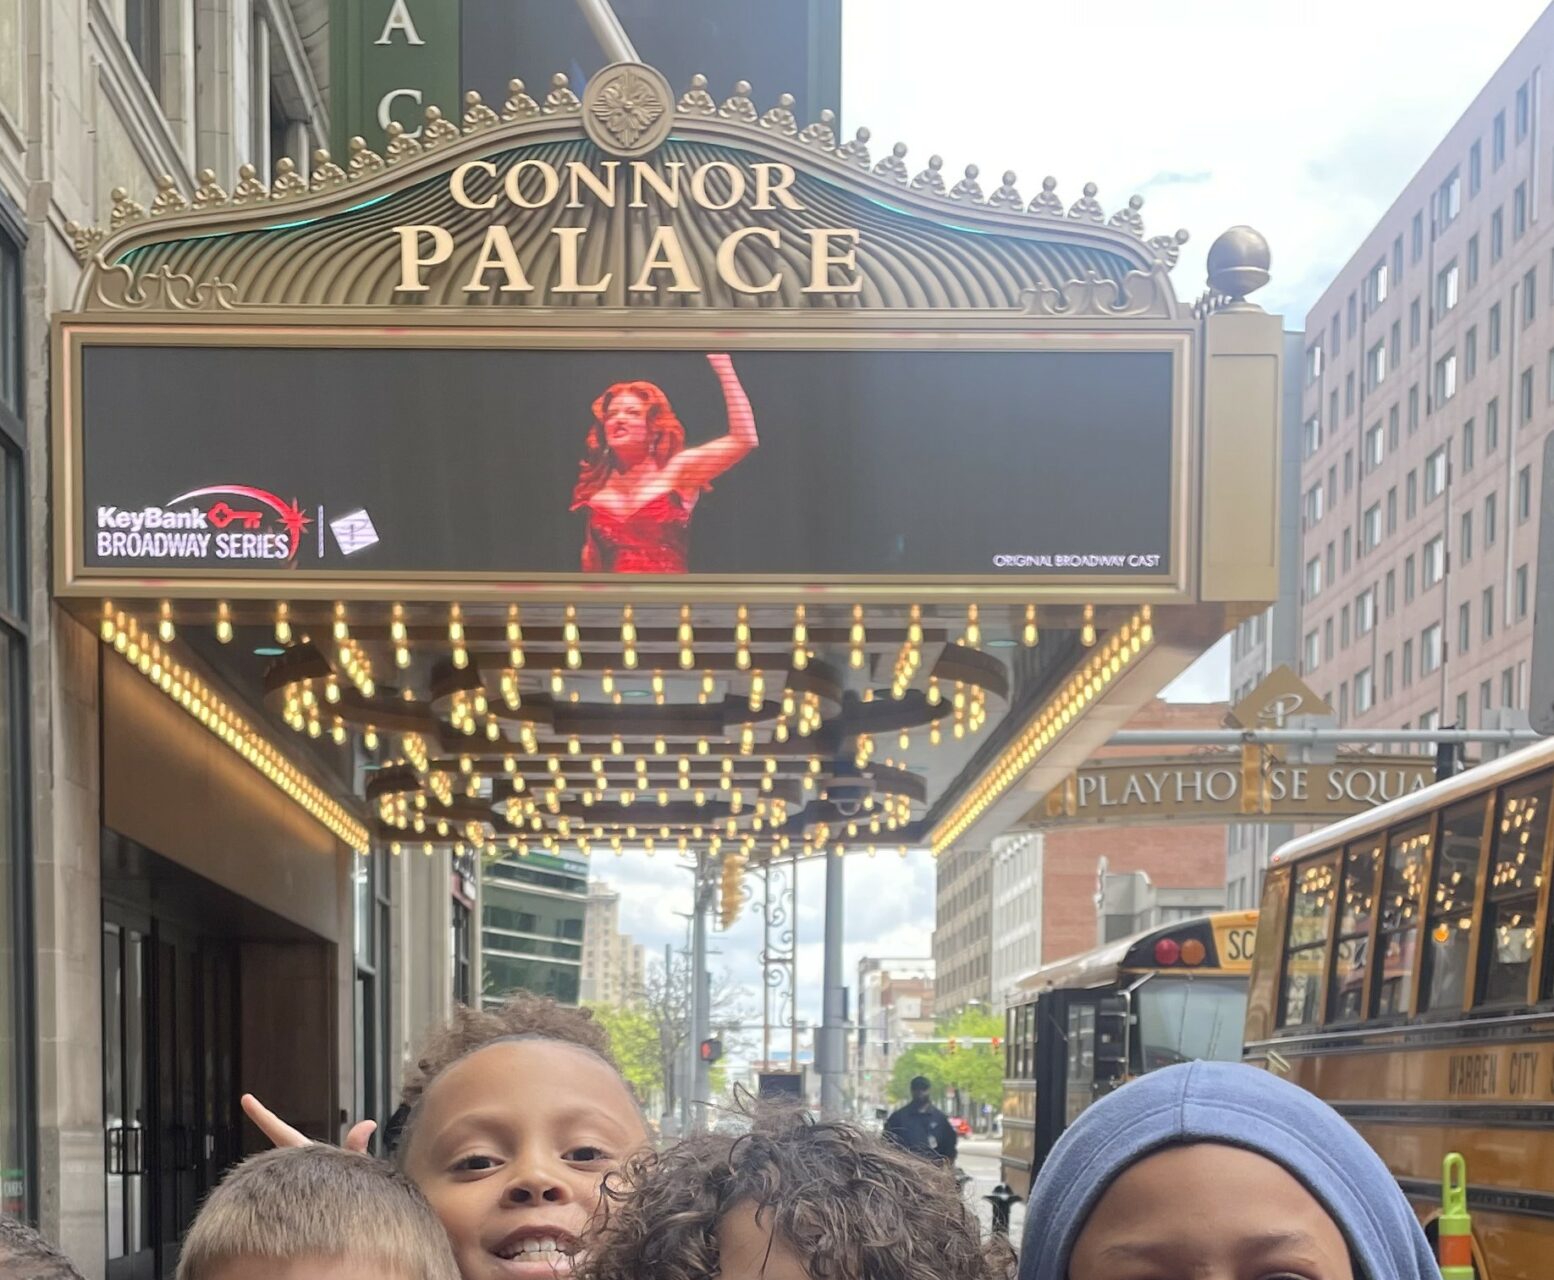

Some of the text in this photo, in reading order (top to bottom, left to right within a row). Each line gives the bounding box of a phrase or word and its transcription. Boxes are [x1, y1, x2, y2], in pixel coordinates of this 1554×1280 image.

[449, 159, 806, 212] CONNOR
[392, 225, 863, 295] PALACE
[97, 506, 209, 532] KeyBank
[97, 532, 290, 560] BROADWAY SERIES
[993, 554, 1161, 568] ORIGINAL BROADWAY CAST
[1078, 767, 1309, 807] PLAYHOSE
[1448, 1051, 1540, 1095] WARREN CITY
